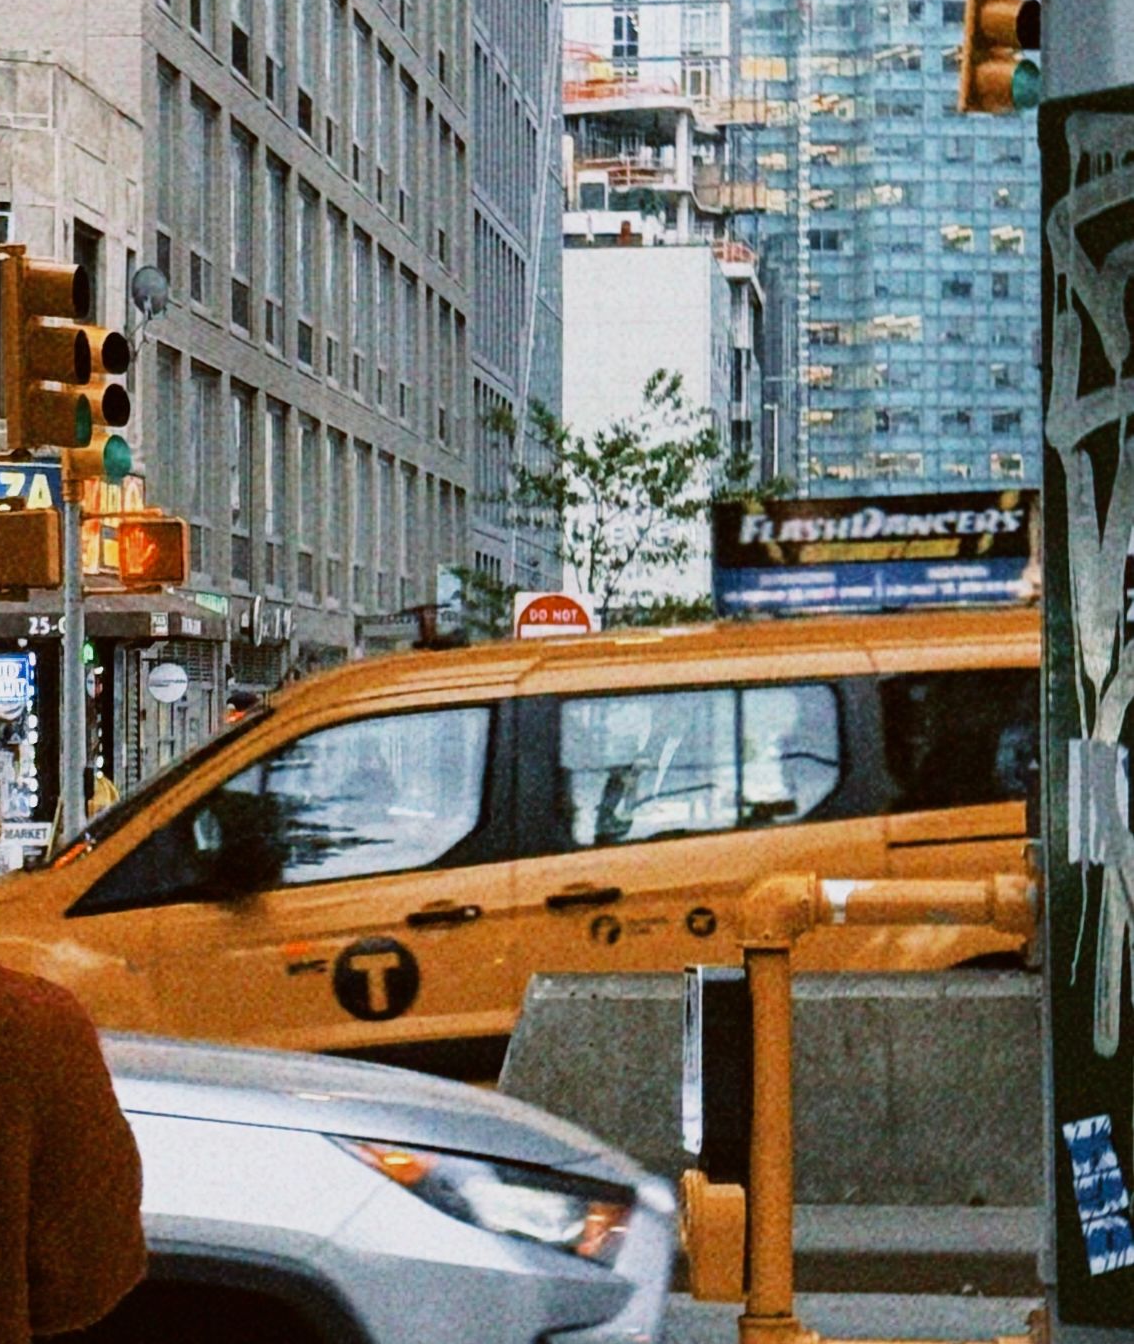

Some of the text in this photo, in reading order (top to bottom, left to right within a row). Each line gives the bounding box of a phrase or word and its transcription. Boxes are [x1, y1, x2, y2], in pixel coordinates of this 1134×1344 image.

[529, 609, 578, 623] DO NOT
[4, 827, 49, 841] MARKET
[350, 954, 401, 1013] T
